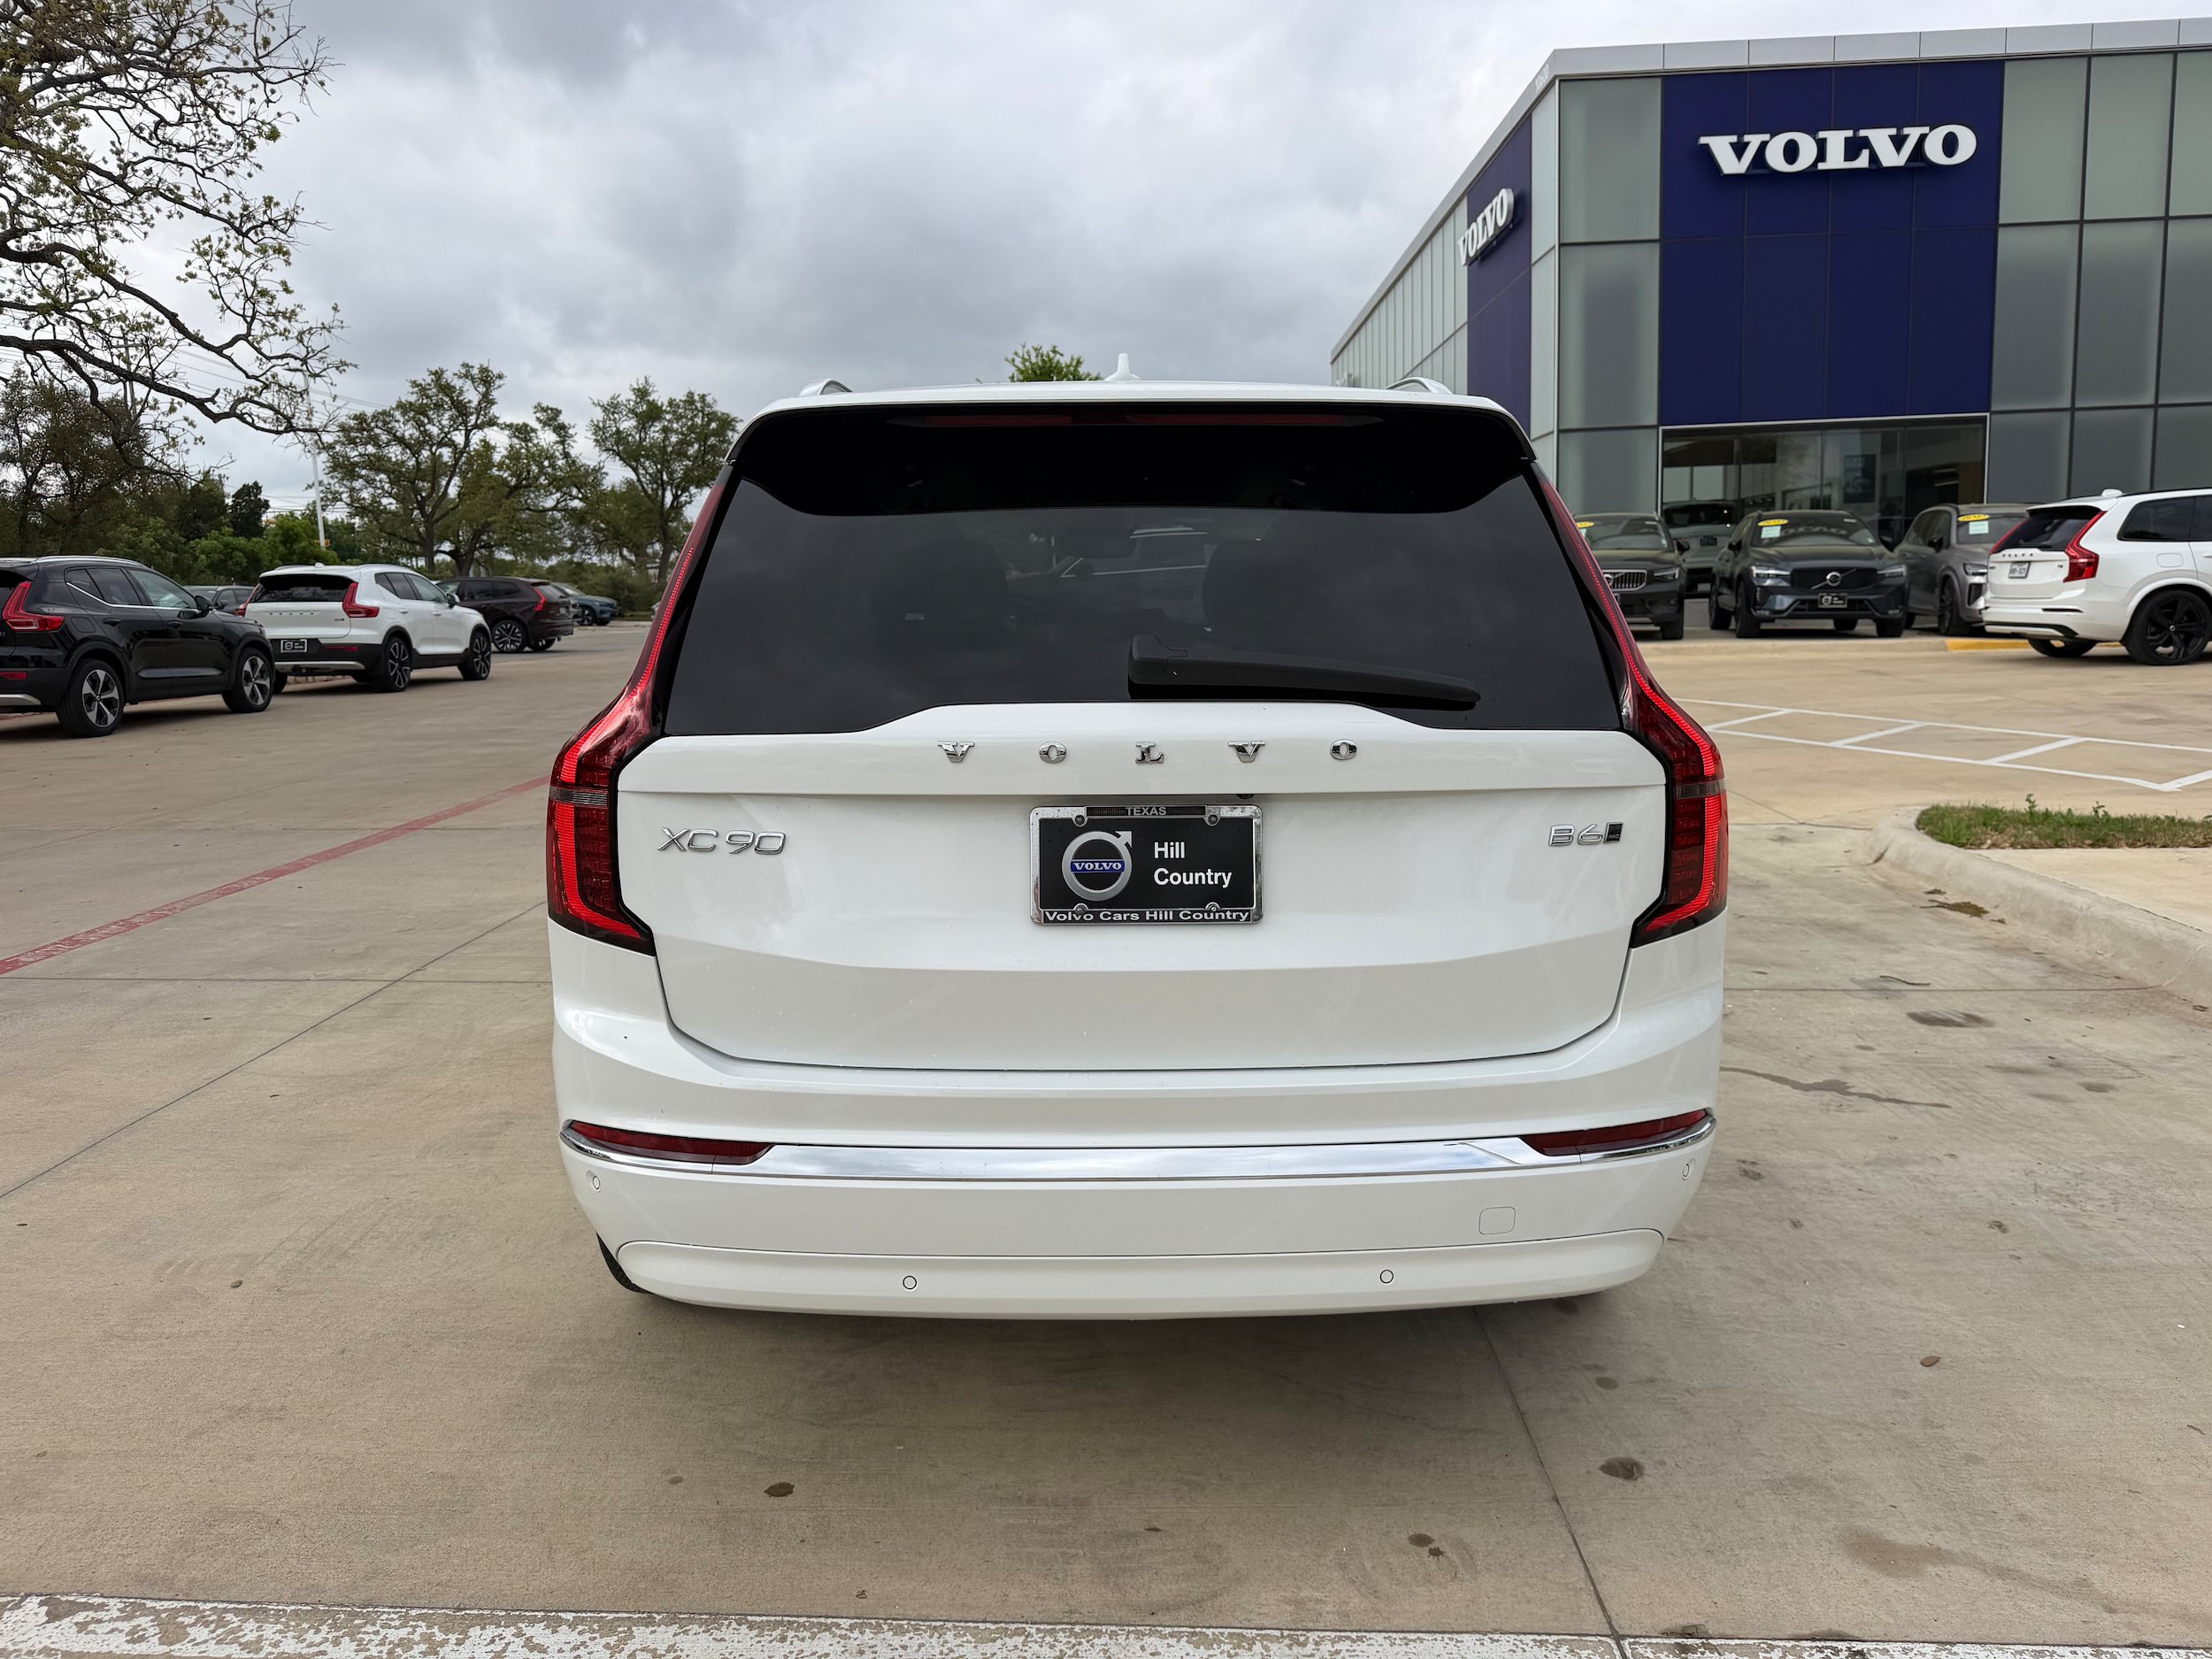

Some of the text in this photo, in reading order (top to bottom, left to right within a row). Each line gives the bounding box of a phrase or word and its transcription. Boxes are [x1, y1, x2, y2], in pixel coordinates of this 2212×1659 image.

[1699, 124, 1977, 175] VOLVO
[1458, 188, 1510, 265] VOLVO
[937, 740, 1358, 764] VOLVO
[1125, 806, 1167, 817] TEXAS
[1153, 841, 1186, 859] Hill
[1073, 862, 1123, 871] VOLVO
[1153, 867, 1233, 888] Country
[1044, 910, 1250, 922] Volvo Cars Hill Country
